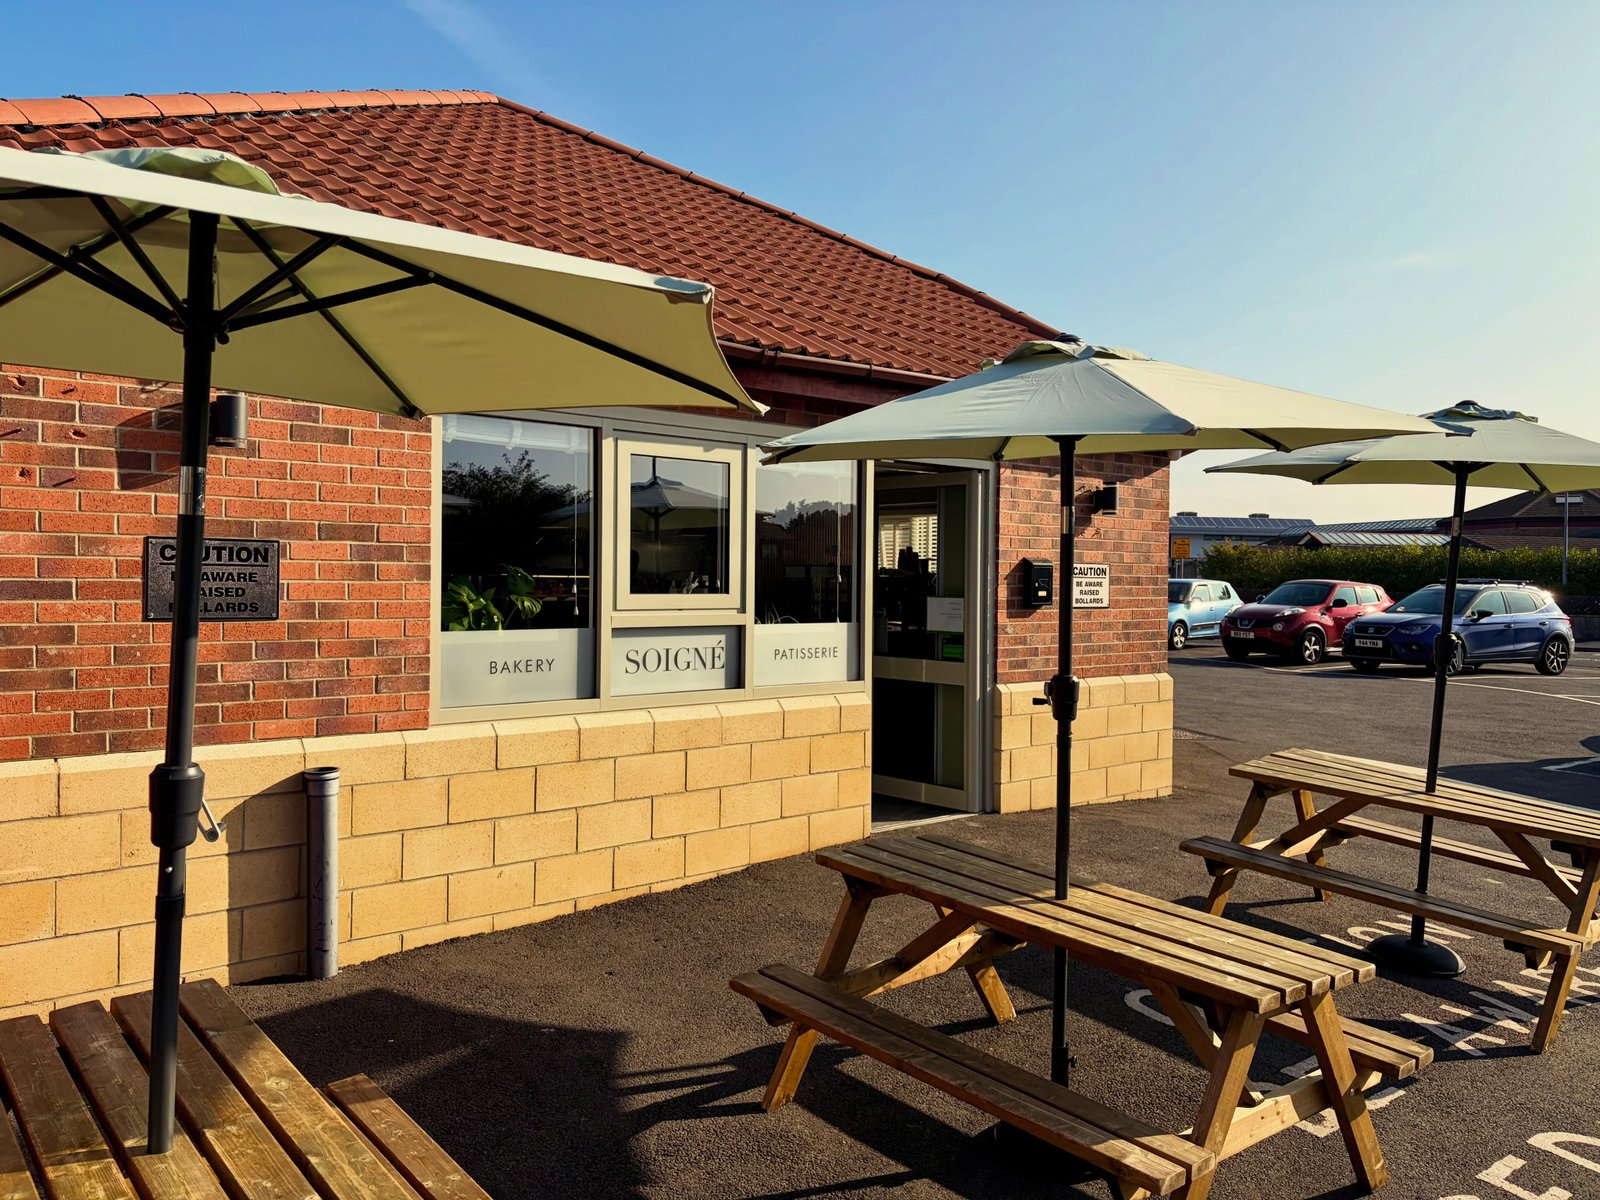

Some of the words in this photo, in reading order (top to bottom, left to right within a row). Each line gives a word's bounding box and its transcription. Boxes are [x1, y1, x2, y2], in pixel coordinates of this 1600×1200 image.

[159, 544, 269, 563] CUTION
[1073, 567, 1106, 576] CAUTION
[199, 586, 246, 598] AISED
[624, 640, 726, 675] SOIGNÉ
[774, 646, 839, 661] PATISSERIE
[489, 658, 555, 675] BAKERY
